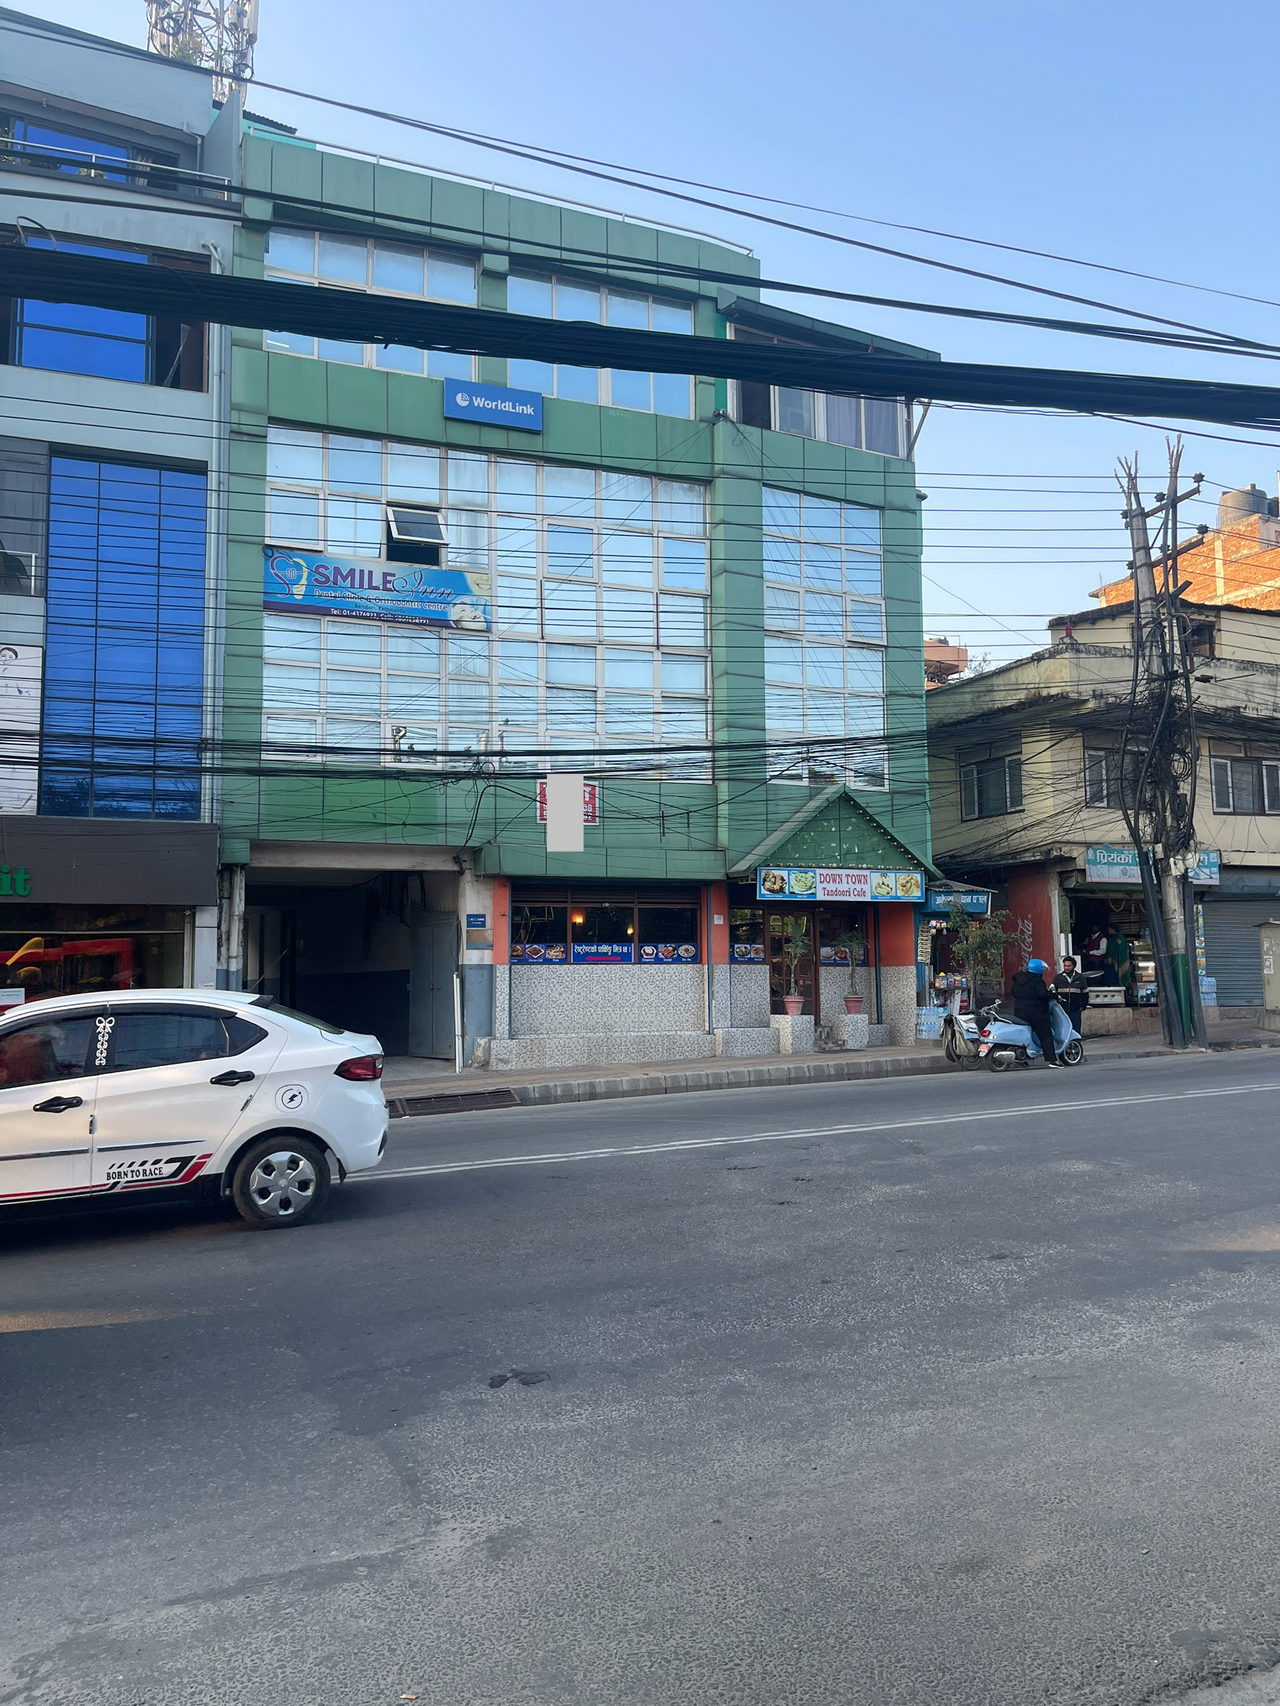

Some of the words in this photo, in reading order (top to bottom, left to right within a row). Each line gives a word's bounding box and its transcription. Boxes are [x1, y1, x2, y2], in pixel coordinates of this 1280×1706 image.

[472, 396, 535, 415] WorldLink
[312, 563, 397, 592] SMILE
[314, 589, 340, 600] Dental
[819, 873, 844, 884] DOWN
[845, 874, 868, 884] TOWN
[822, 887, 851, 897] Tandoori
[853, 888, 866, 897] Cafe
[107, 1170, 129, 1180] BORN
[130, 1169, 141, 1178] TO
[142, 1167, 163, 1177] RACE
